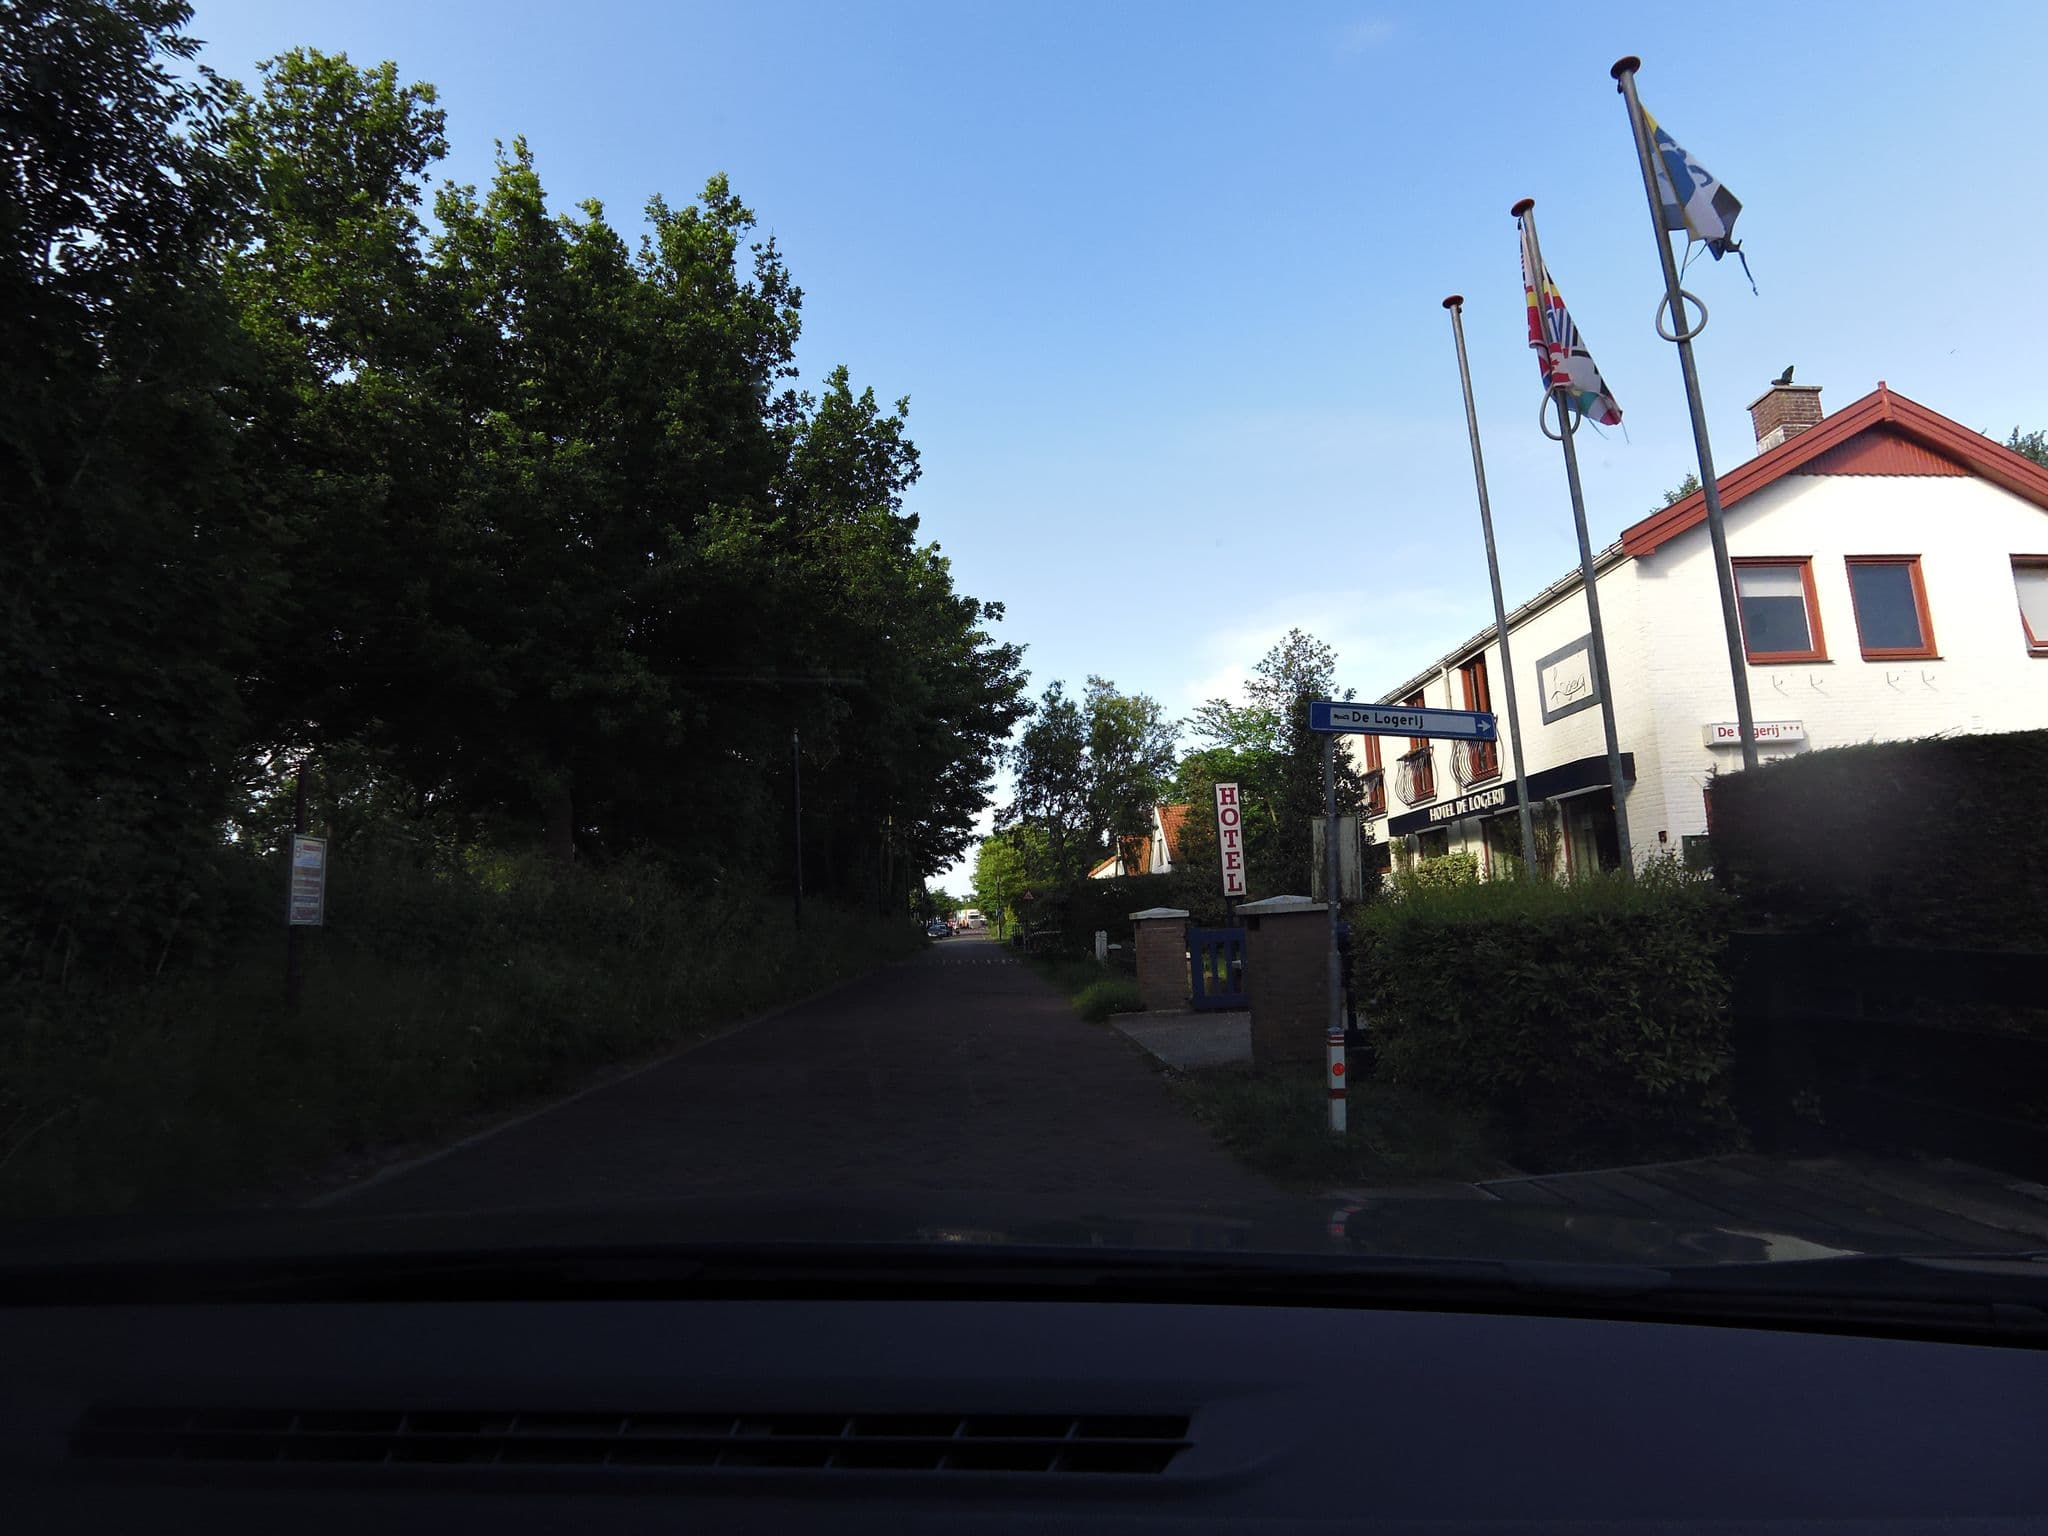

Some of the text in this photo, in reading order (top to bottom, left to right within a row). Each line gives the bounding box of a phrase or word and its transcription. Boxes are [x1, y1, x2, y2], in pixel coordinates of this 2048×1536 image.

[1351, 711, 1424, 729] De Logerij
[1717, 724, 1780, 739] De Lgerij
[1429, 787, 1505, 822] HOTEL DE LOGERIJ
[1218, 787, 1243, 892] HOTEL
